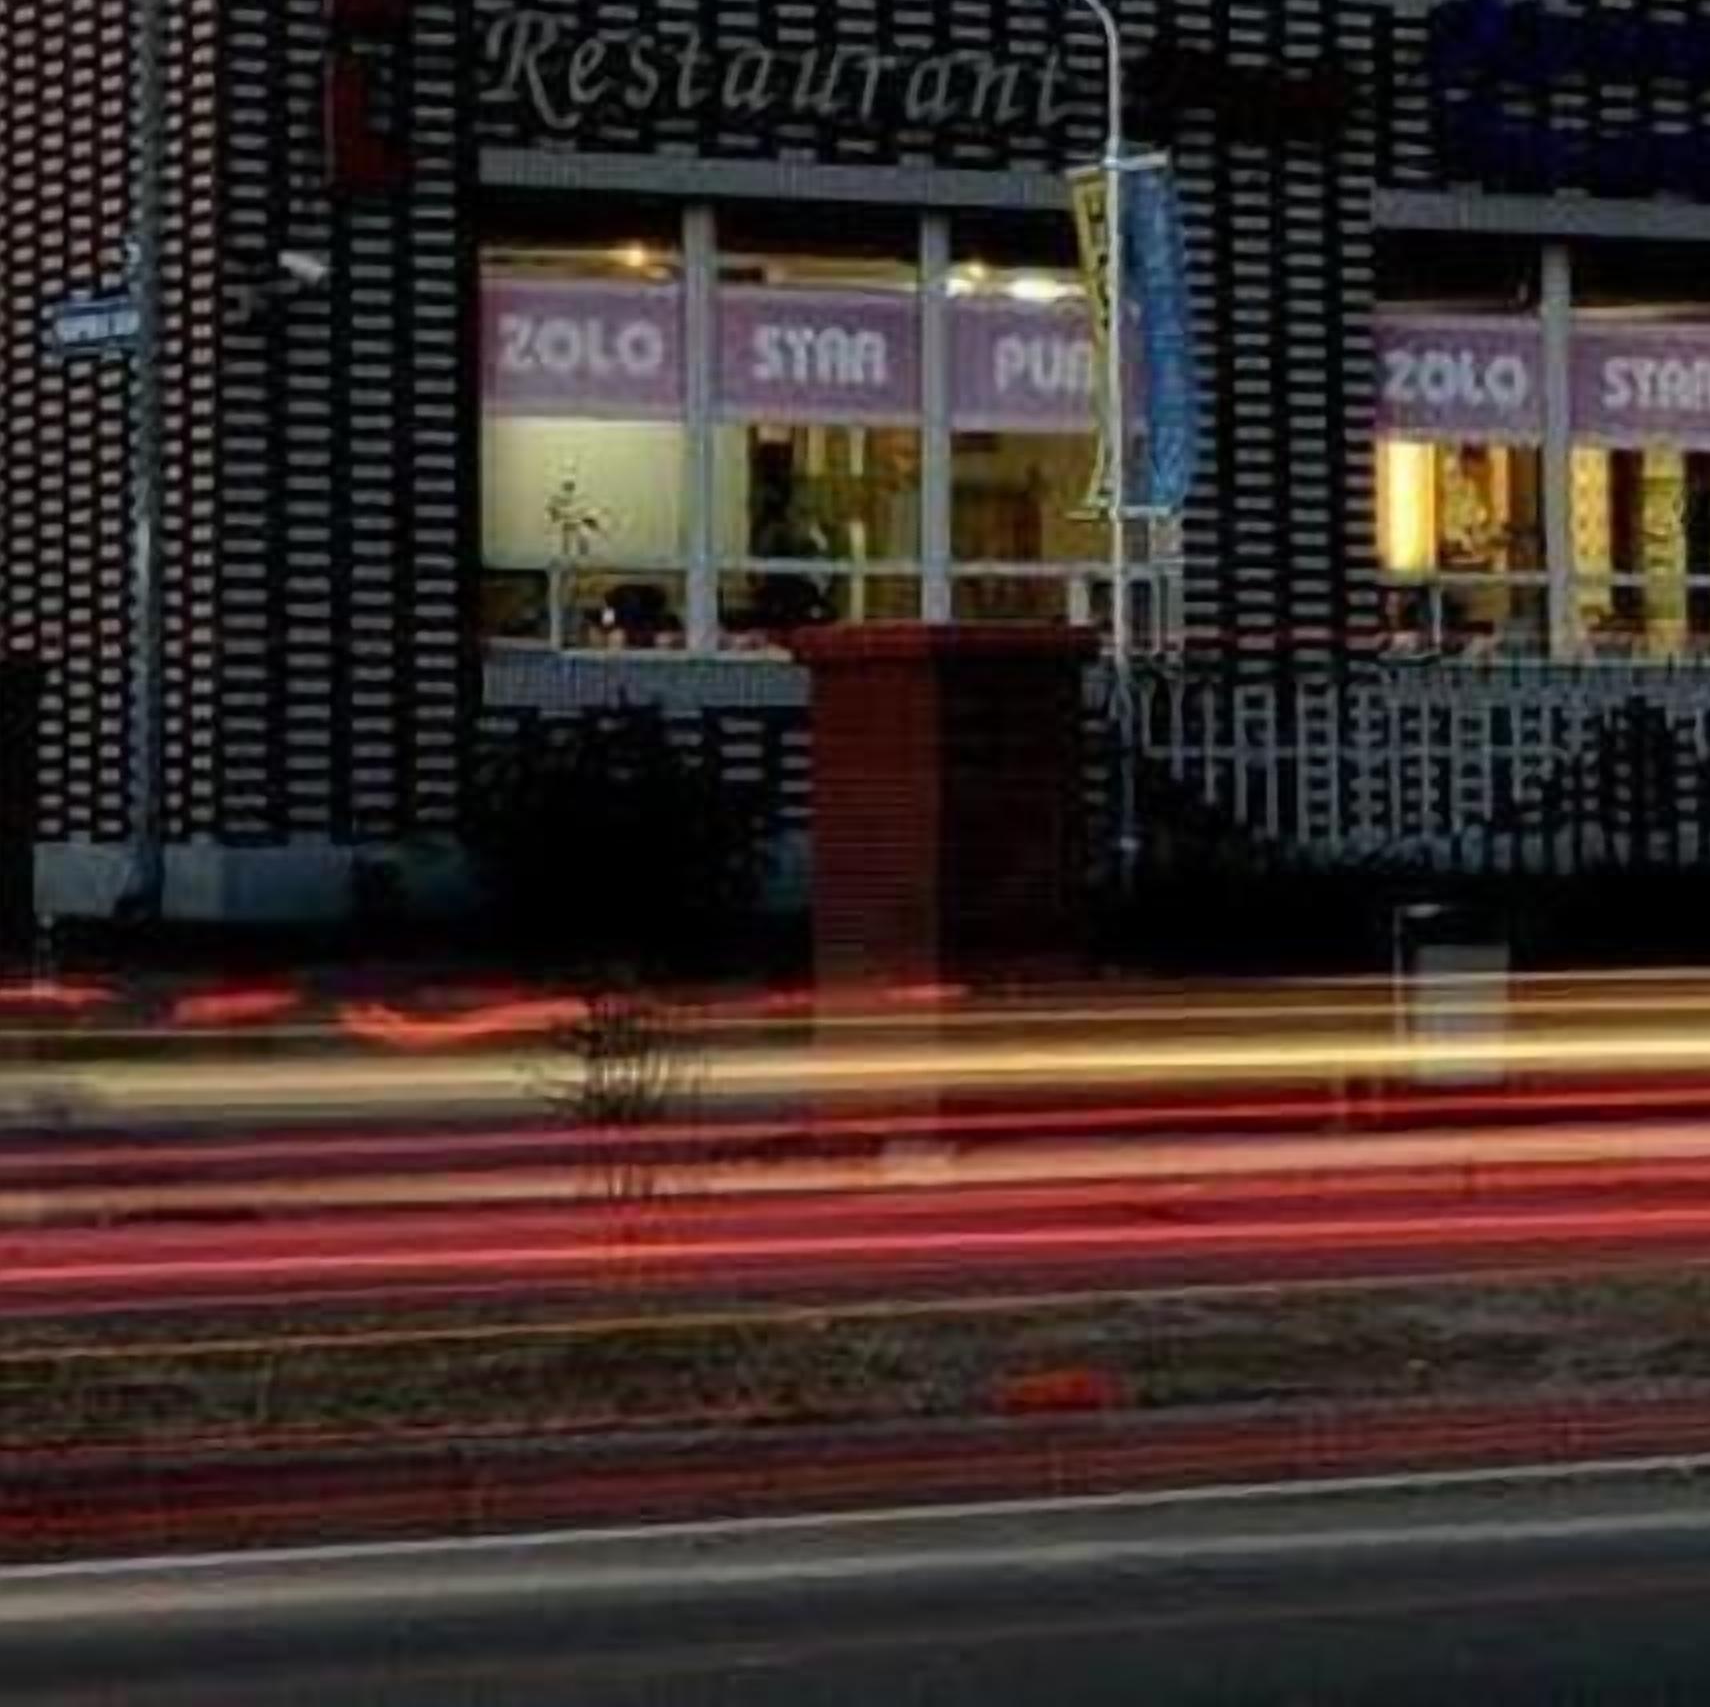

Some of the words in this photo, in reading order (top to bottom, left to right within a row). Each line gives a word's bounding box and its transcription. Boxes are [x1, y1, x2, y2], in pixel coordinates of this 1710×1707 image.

[487, 7, 1078, 128] Restaurant
[499, 314, 664, 374] ZOLO
[751, 323, 887, 385] STAR
[1382, 349, 1529, 408] ZOLO
